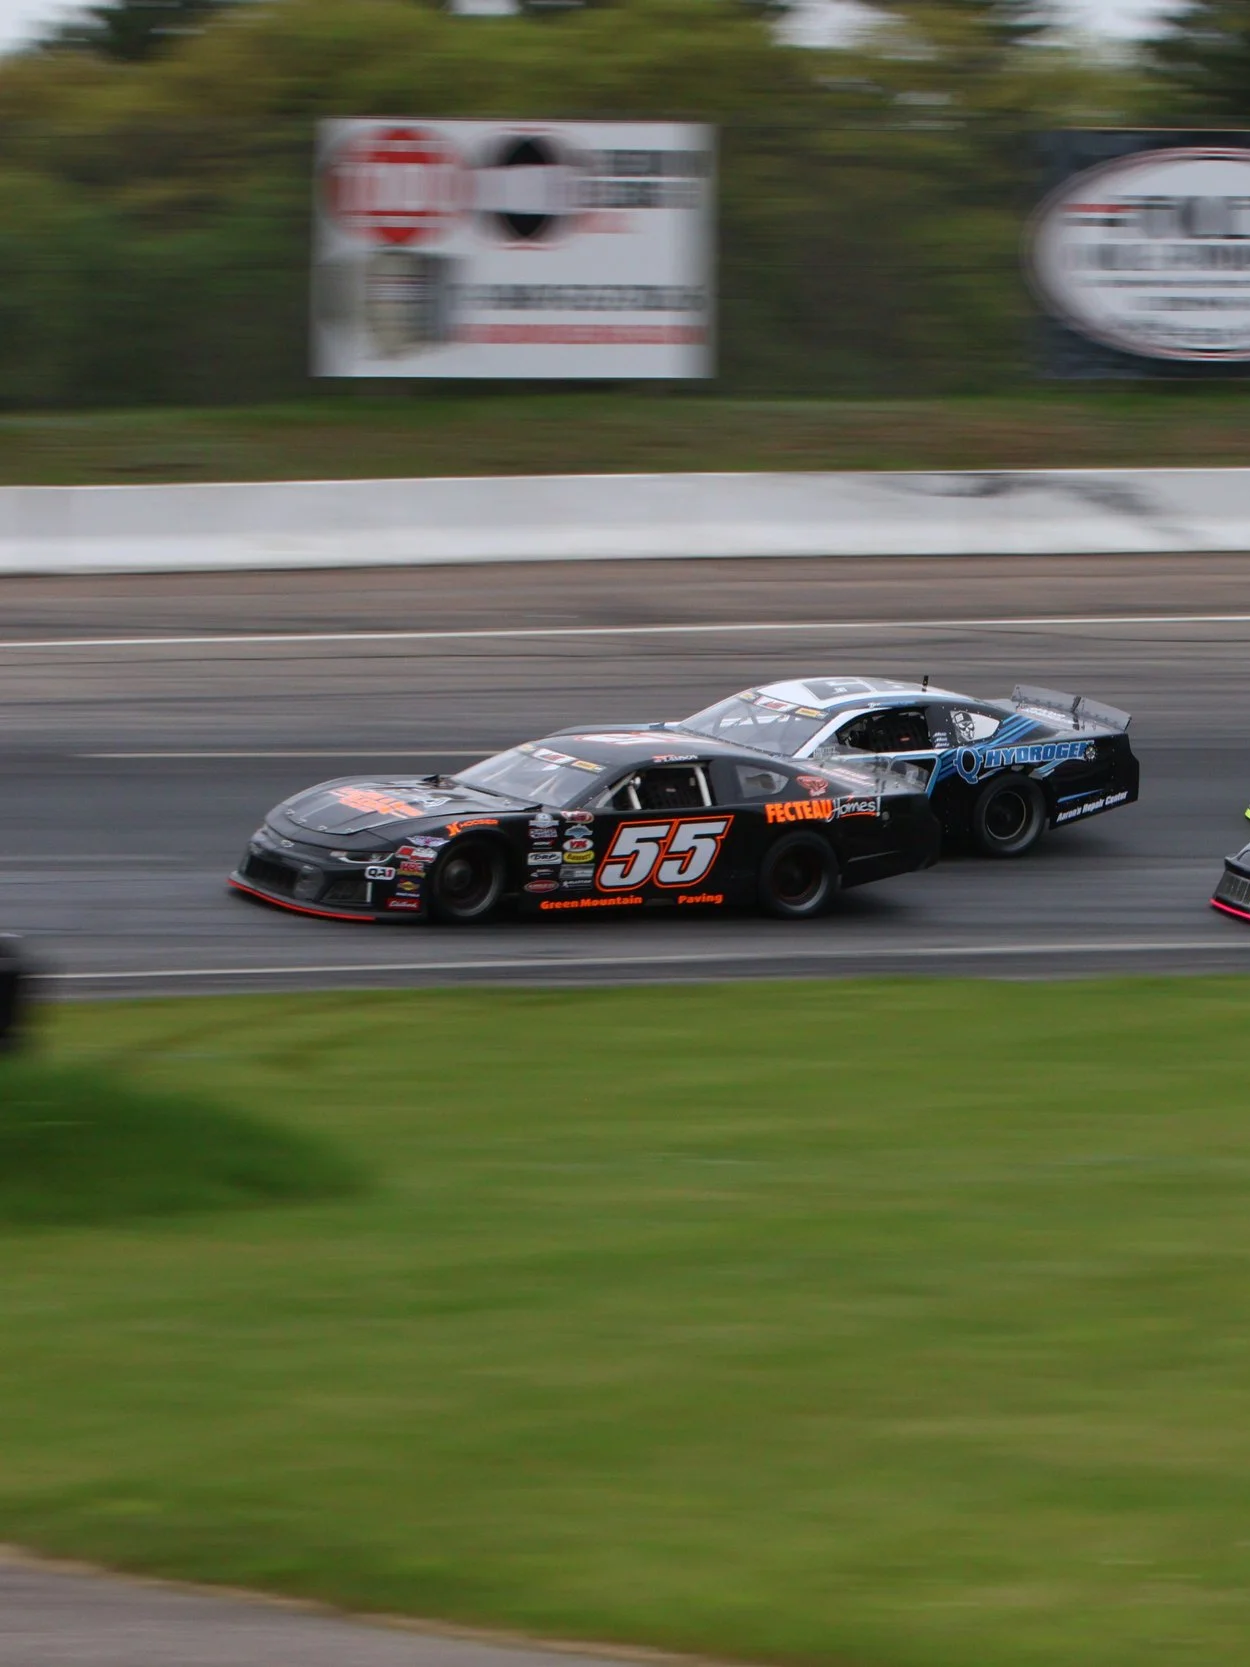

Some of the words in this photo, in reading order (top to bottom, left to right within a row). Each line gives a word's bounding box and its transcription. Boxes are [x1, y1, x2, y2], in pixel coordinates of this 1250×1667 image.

[1105, 790, 1129, 806] Center
[765, 799, 833, 824] FECTEAU
[595, 814, 735, 893] 55
[367, 868, 394, 878] QA1
[540, 899, 580, 910] Green
[580, 894, 644, 907] Mountain
[678, 893, 723, 905] Paving
